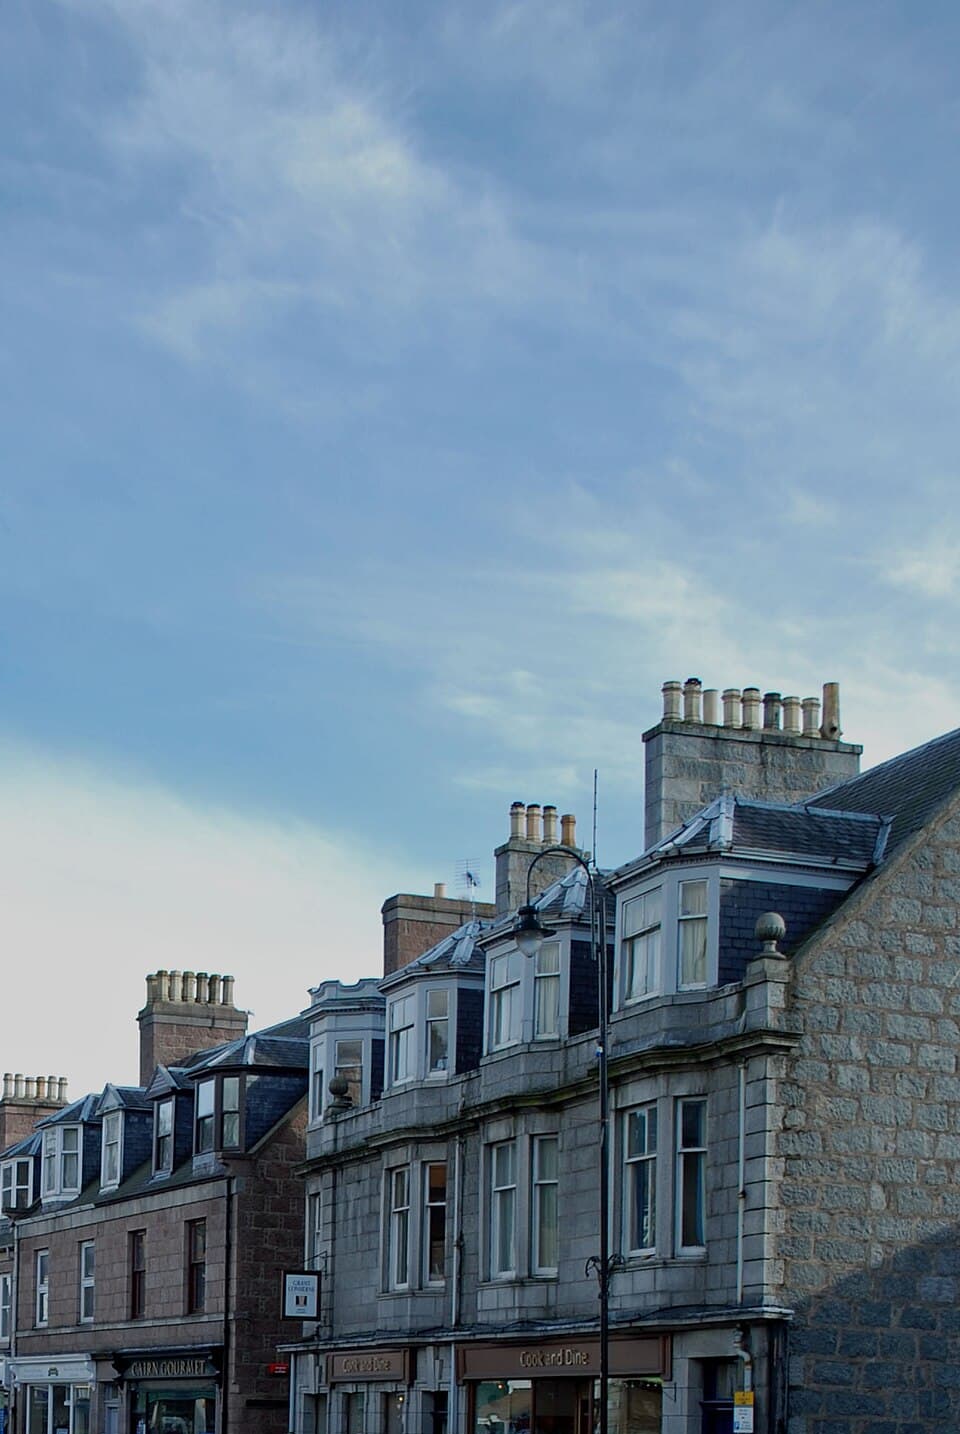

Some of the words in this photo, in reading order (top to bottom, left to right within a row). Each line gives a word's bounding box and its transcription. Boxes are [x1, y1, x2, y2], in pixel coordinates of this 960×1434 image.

[519, 1351, 544, 1367] Cook
[545, 1348, 563, 1366] and
[565, 1348, 589, 1366] Dine
[131, 1361, 158, 1376] CAIRN
[160, 1359, 206, 1376] GOURMET
